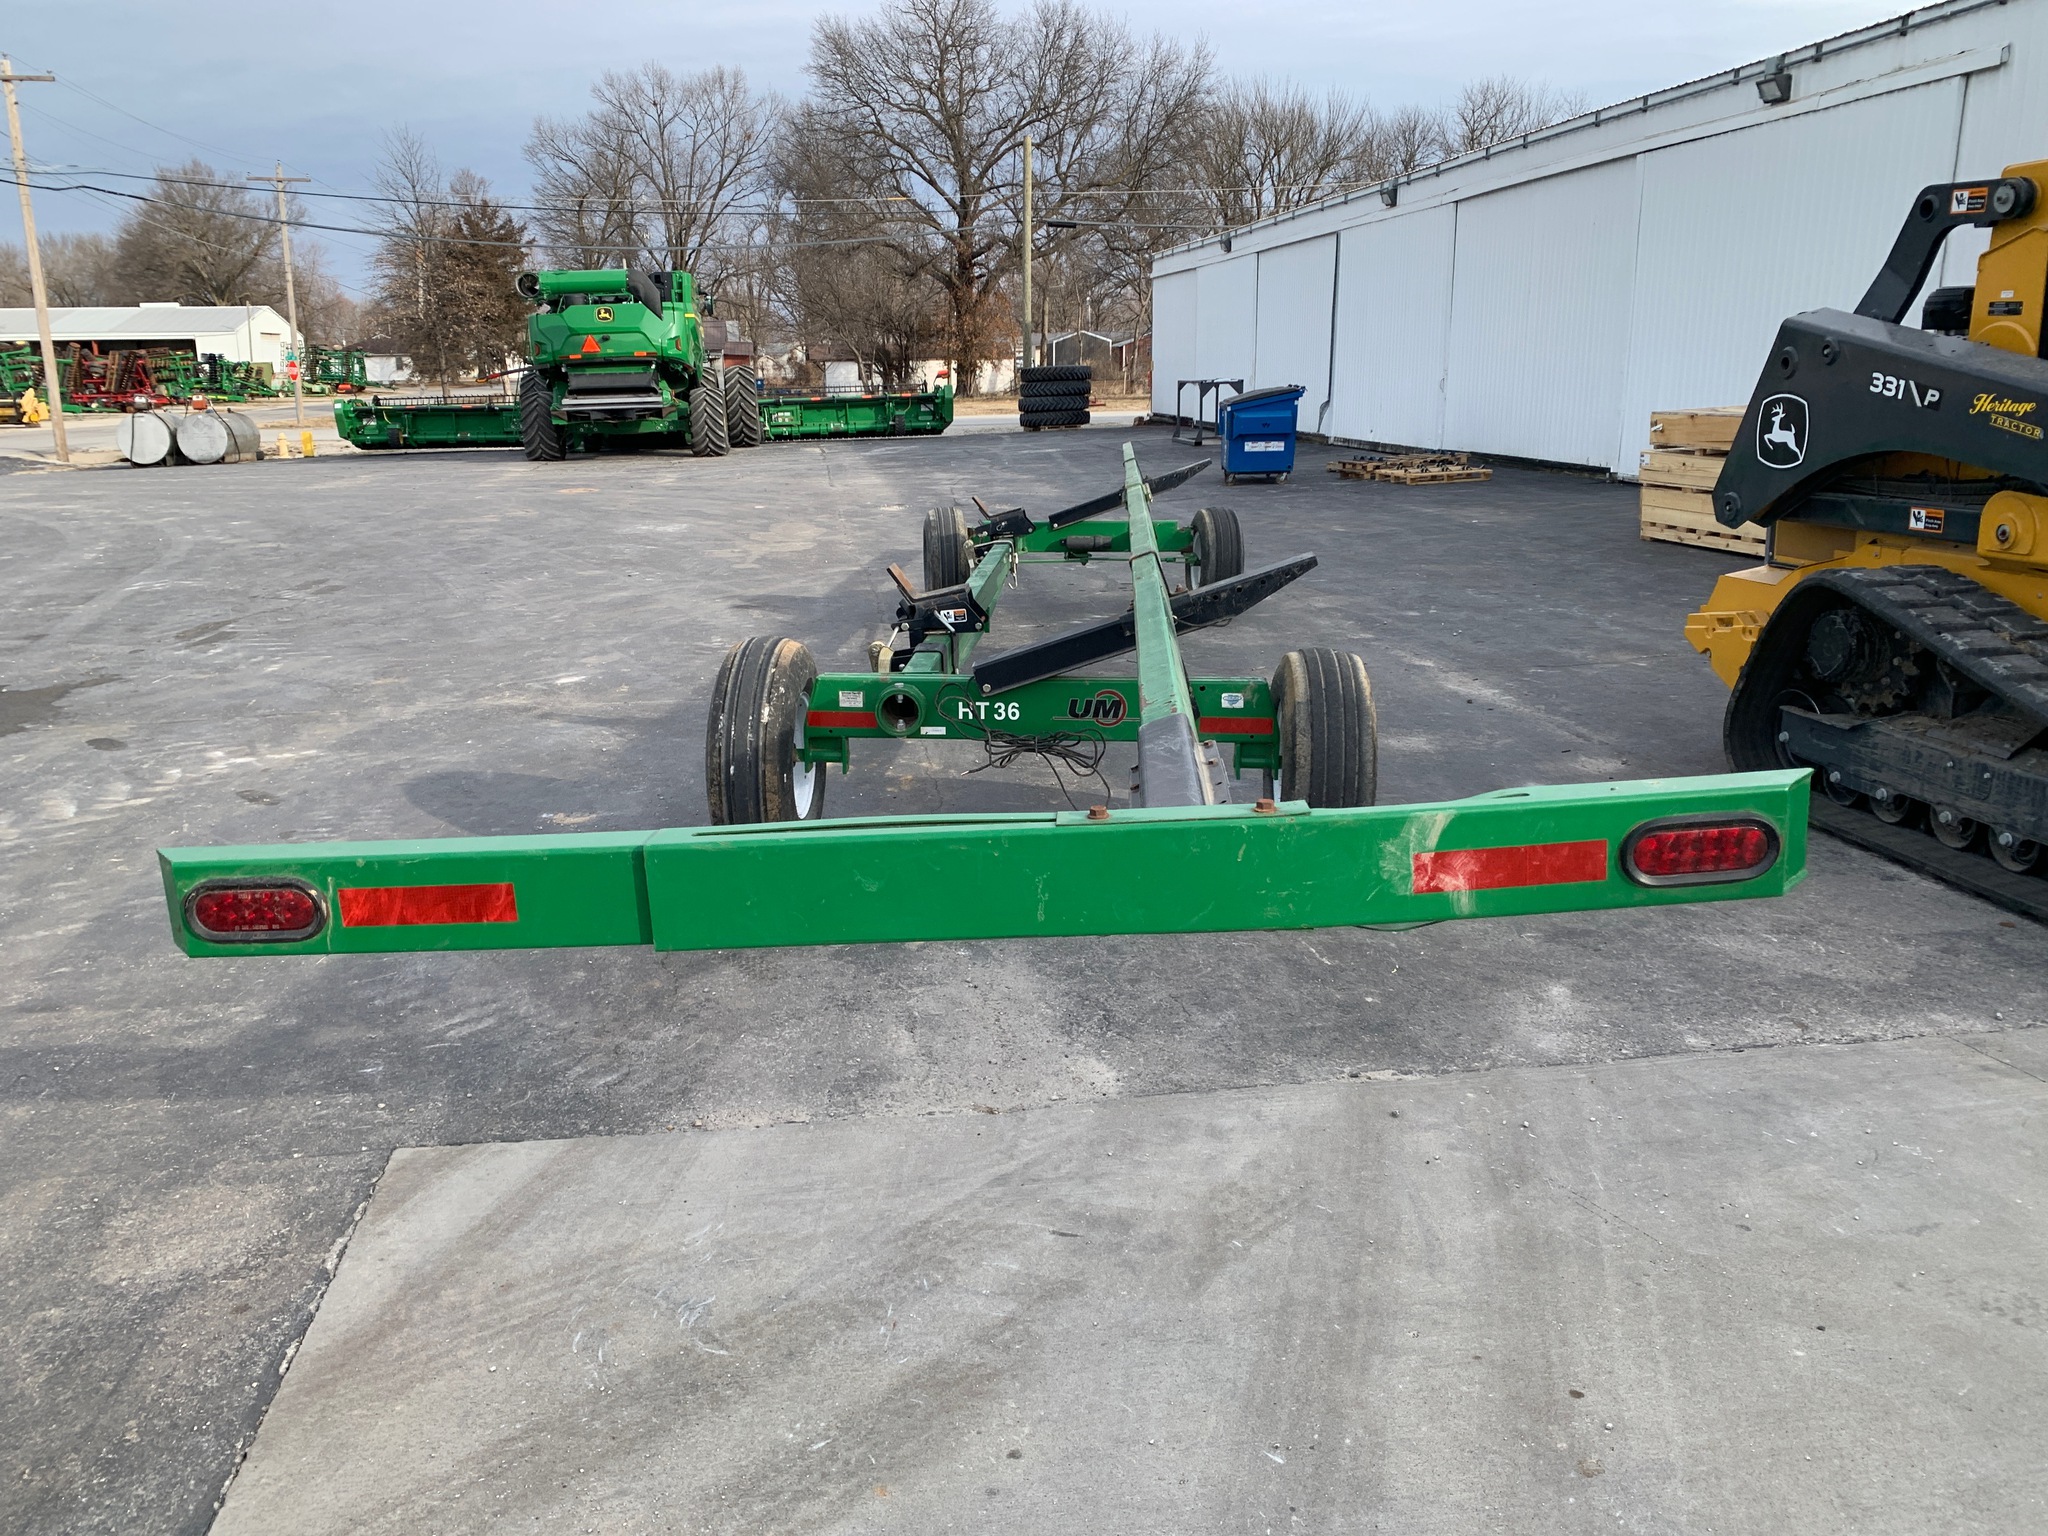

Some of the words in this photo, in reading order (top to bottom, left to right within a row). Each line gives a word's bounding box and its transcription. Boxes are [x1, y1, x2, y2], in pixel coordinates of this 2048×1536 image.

[1969, 393, 2037, 417] Heritage
[1991, 414, 2041, 438] TRACTOR
[1067, 698, 1124, 719] UM
